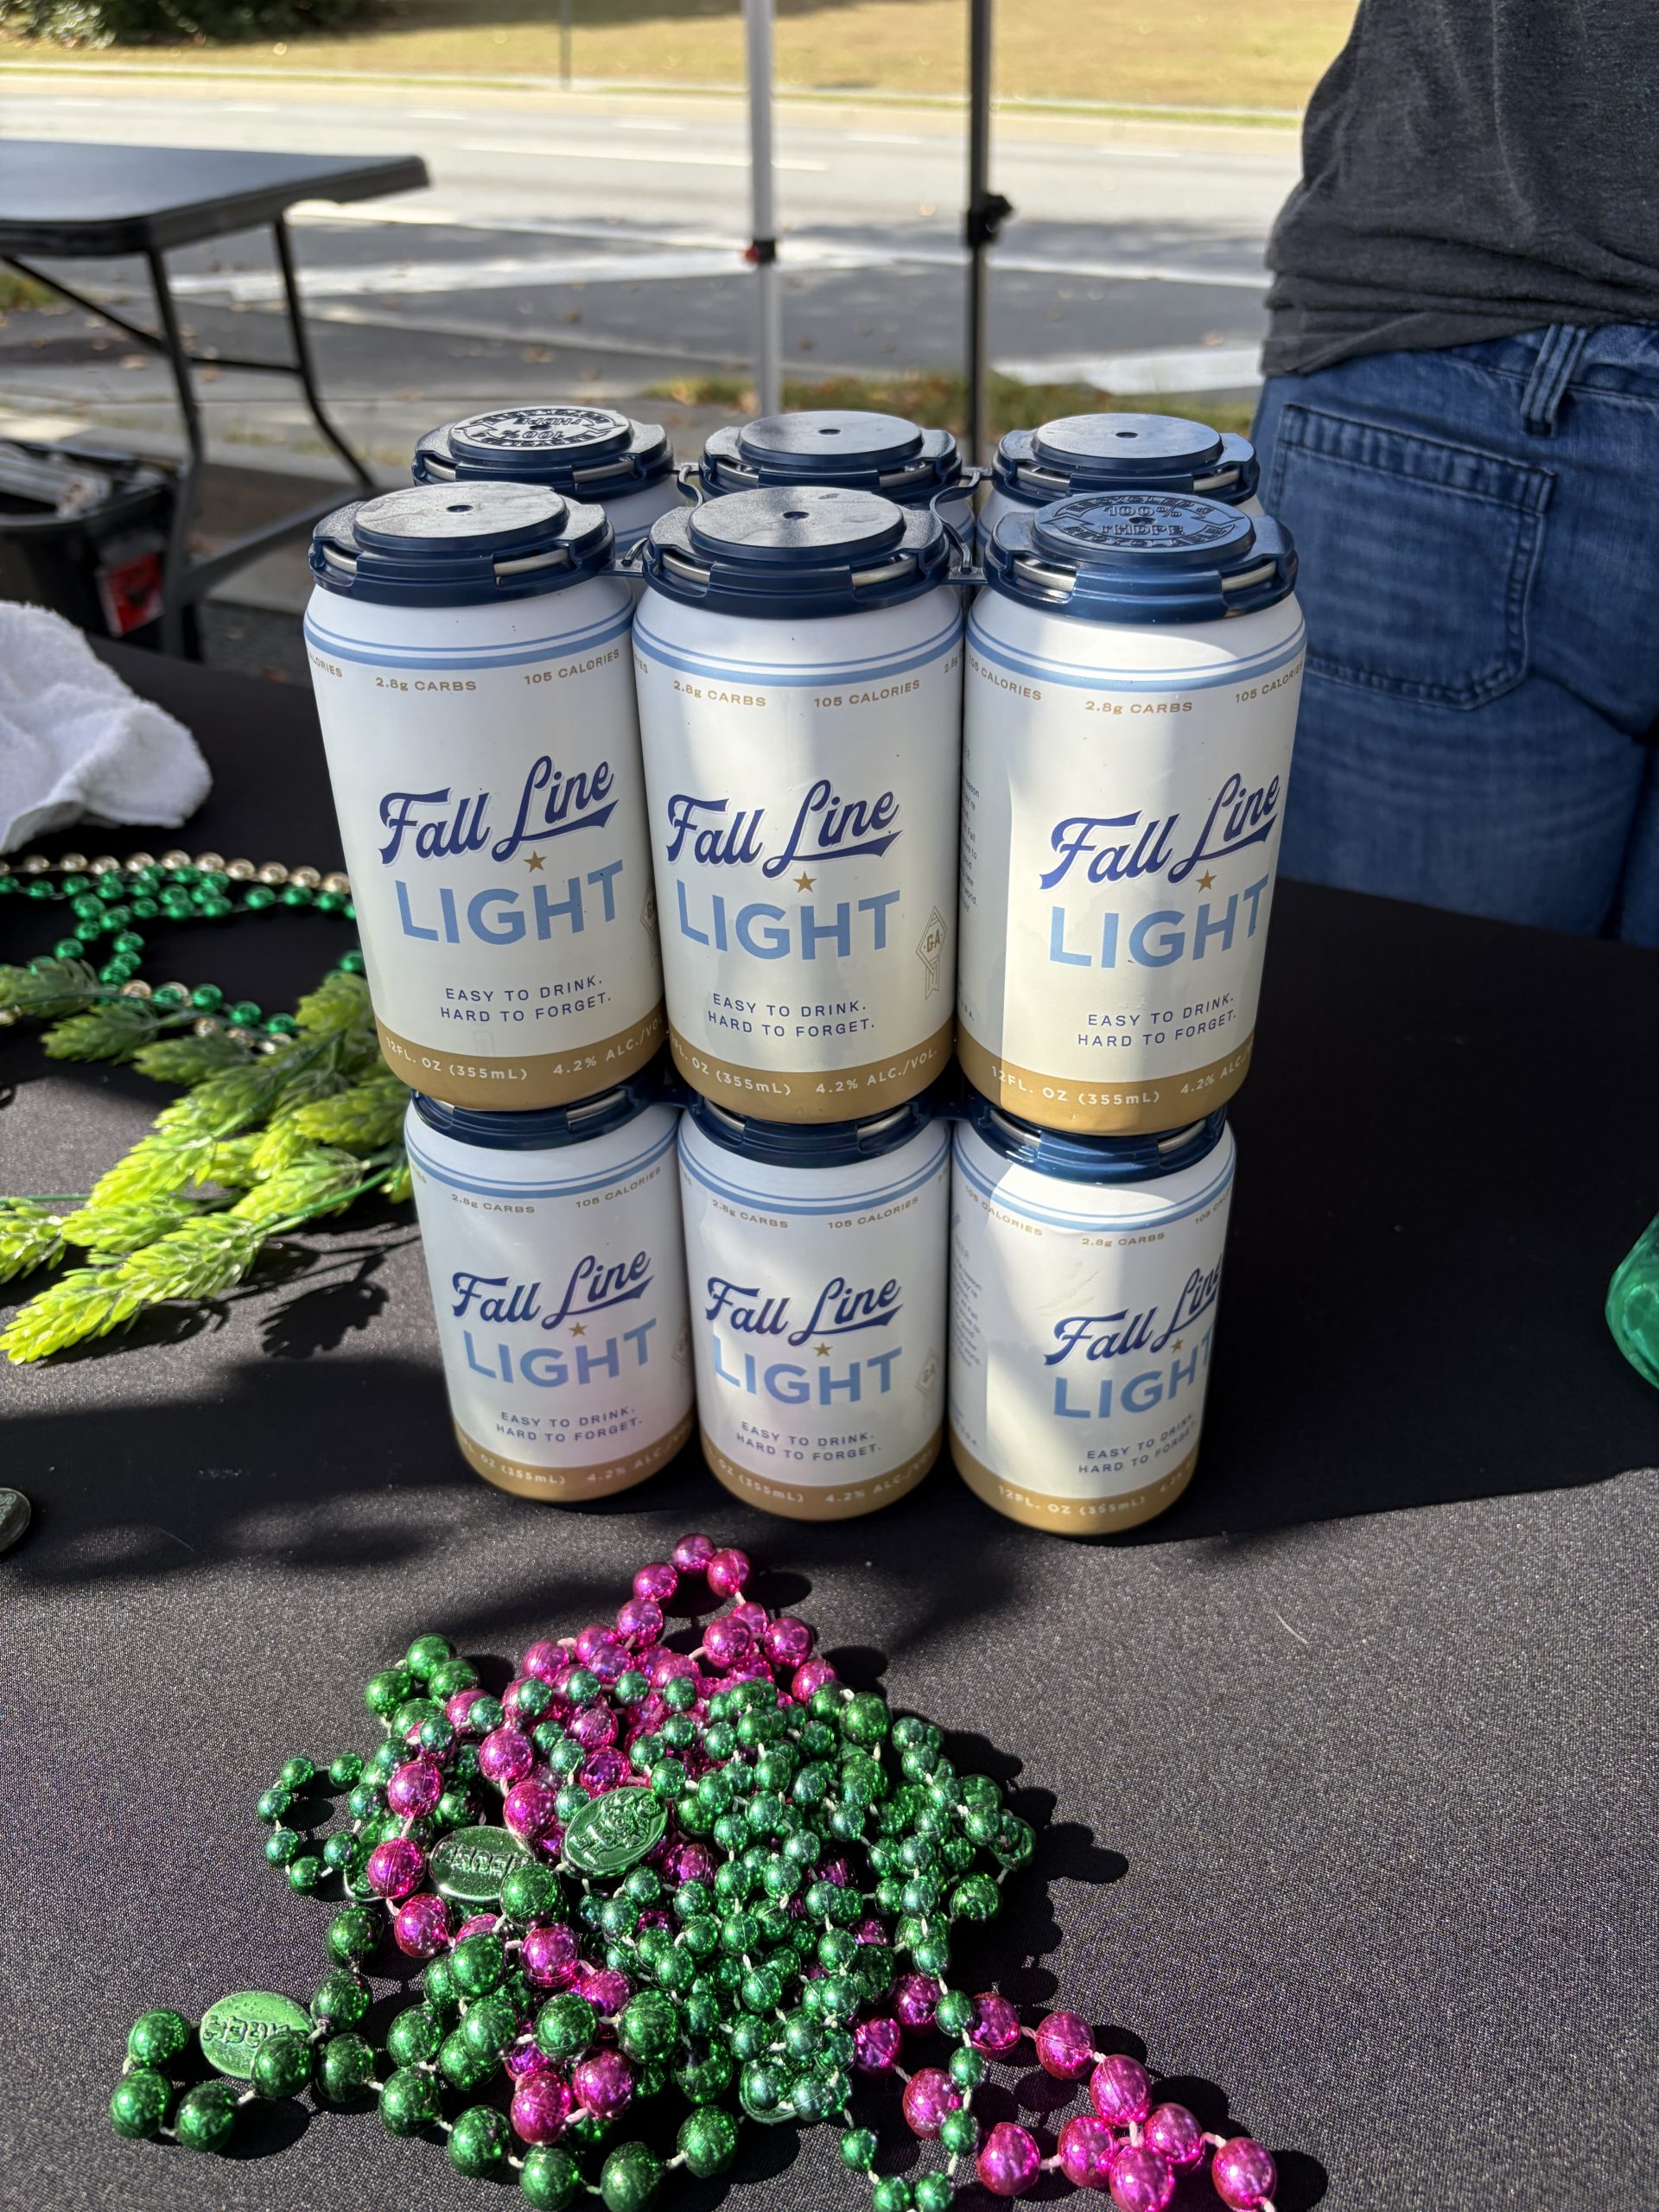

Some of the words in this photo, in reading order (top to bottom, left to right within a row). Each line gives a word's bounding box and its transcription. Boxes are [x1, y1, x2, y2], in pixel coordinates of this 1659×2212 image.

[1103, 505, 1181, 518] 100%
[1099, 524, 1185, 536] rHDPE
[524, 671, 553, 686] 105
[558, 649, 620, 678] CALORIES
[375, 677, 409, 692] 2.8g
[414, 680, 477, 692] CARBS
[674, 680, 702, 698] 2.8g
[708, 690, 766, 707] CARBS
[814, 696, 842, 708] 105
[849, 679, 920, 704] CALORIES
[982, 667, 1042, 701] CALORIES
[1235, 690, 1257, 703] 105
[1085, 700, 1123, 715] 2.8g
[1130, 702, 1192, 715] CARBS
[378, 786, 491, 865] Fall
[491, 755, 620, 863] Line
[665, 793, 766, 865] Fall
[761, 779, 903, 879] Line
[1039, 810, 1180, 890] Fall
[1167, 772, 1281, 885] Line
[395, 859, 624, 945] LIGHT
[677, 879, 900, 960] LIGHT
[1049, 874, 1270, 969] LIGHT
[926, 929, 941, 952] GA
[446, 988, 494, 1002] EASY
[505, 989, 529, 1001] TO
[540, 975, 603, 999] DRINK.
[441, 1007, 490, 1022] HARD
[500, 1010, 524, 1022] TO
[536, 992, 612, 1020] FORGET.
[713, 993, 756, 1014] EASY
[766, 1005, 790, 1017] TO
[801, 1000, 866, 1017] DRINK.
[1088, 1014, 1140, 1027] EASY
[1151, 1011, 1173, 1024] TO
[1183, 993, 1234, 1019] DRINK.
[708, 1011, 753, 1033] HARD
[761, 1025, 785, 1037] TO
[796, 1018, 875, 1038] FORGET.
[1077, 1034, 1132, 1047] HARD
[1142, 1033, 1165, 1046] TO
[1175, 1008, 1236, 1040] FORGET.
[386, 1037, 416, 1064] 12FL.
[422, 1056, 442, 1071] OZ
[449, 1065, 528, 1081] (355mL)
[553, 1056, 597, 1076] 4.2%
[816, 1078, 859, 1094] 4.2%
[867, 1050, 938, 1086] ALC./VOL.
[692, 1057, 709, 1075] OZ
[716, 1070, 791, 1096] (355mL)
[991, 1066, 1034, 1094] 12FL.
[1042, 1087, 1068, 1102] OZ
[1077, 1092, 1160, 1106] (355mL)
[1180, 1075, 1215, 1095] 4.2%
[575, 1197, 601, 1209] 105
[605, 1166, 662, 1201] CALORIES
[451, 1193, 478, 1209] 2.8g
[483, 1202, 535, 1214] CARBS
[712, 1198, 736, 1217] 2.8g
[741, 1211, 789, 1229] CARBS
[828, 1219, 853, 1230] 105
[857, 1196, 919, 1225] CALORIES
[982, 1201, 1043, 1236] CALORIES
[1081, 1237, 1113, 1248] 2.8g
[1118, 1232, 1165, 1246] CARBS
[451, 1271, 542, 1323] Fall
[541, 1250, 655, 1330] Line
[705, 1276, 791, 1335] Fall
[787, 1276, 904, 1346] Line
[1043, 1306, 1158, 1365] Fall
[463, 1318, 657, 1388] LIGHT
[713, 1333, 903, 1406] LIGHT
[497, 1423, 537, 1441] HARD
[544, 1433, 566, 1442] TO
[575, 1416, 642, 1441] FORGET.
[501, 1411, 541, 1427] EASY
[550, 1418, 570, 1427] TO
[579, 1406, 635, 1427] DRINK.
[736, 1433, 776, 1455] HARD
[785, 1450, 804, 1460] TO
[812, 1444, 881, 1461] FORGET.
[741, 1421, 780, 1441] EASY
[788, 1436, 810, 1446] TO
[817, 1432, 874, 1447] DRINK.
[1087, 1446, 1129, 1459] EASY
[1138, 1438, 1155, 1451] TO
[480, 1454, 496, 1468] OZ
[501, 1465, 567, 1485] (355mL)
[1079, 1461, 1123, 1473] HARD
[1131, 1454, 1149, 1466] TO
[739, 1473, 804, 1503] (355mL)
[1047, 1503, 1071, 1515] OZ
[1079, 1496, 1147, 1516] (355mL)
